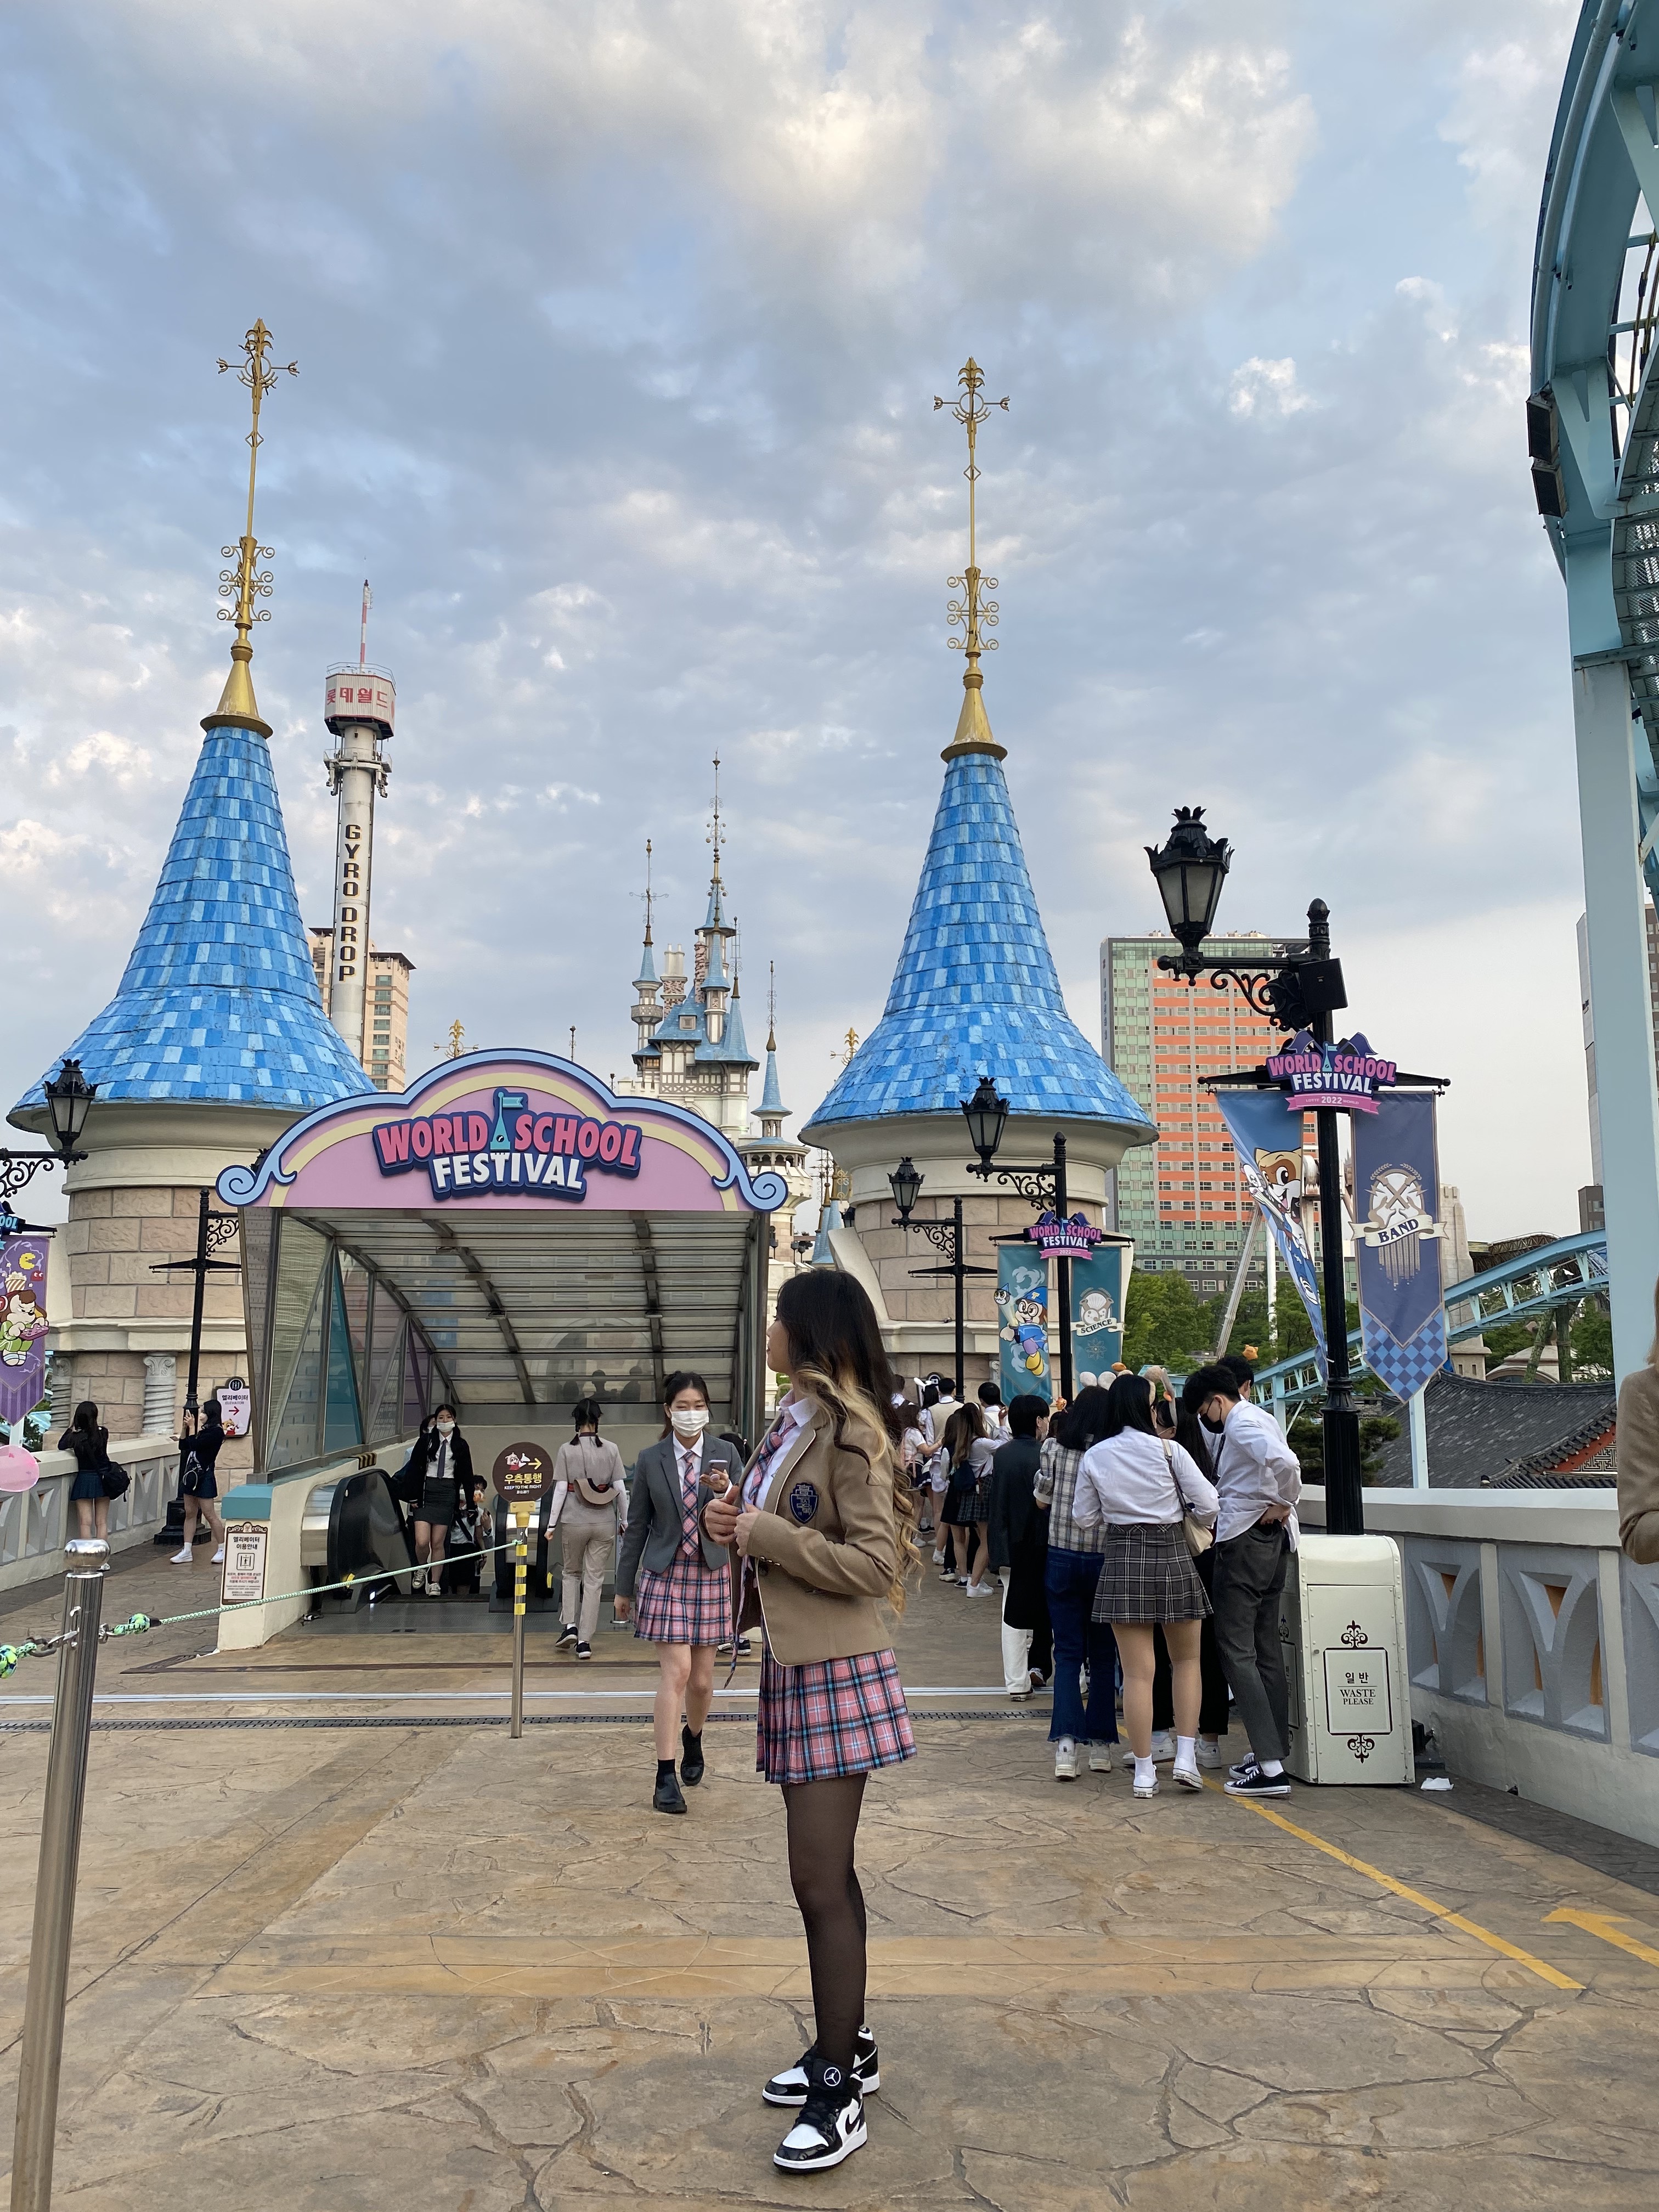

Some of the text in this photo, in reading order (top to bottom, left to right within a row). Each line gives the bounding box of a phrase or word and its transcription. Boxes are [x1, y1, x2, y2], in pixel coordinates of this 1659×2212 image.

[326, 687, 388, 708] 롯데월드
[339, 824, 362, 982] GYRO DROP
[1268, 1054, 1396, 1082] WORLD SCHOOL
[1291, 1072, 1373, 1094] FESTIVAL
[1321, 1096, 1342, 1104] 2022
[377, 1114, 638, 1166] WORLD SCHOOL
[432, 1152, 583, 1190] FESTIVAL
[1029, 1224, 1102, 1240] WORLD SCHOOL
[1378, 1218, 1419, 1243] BAND
[1042, 1235, 1089, 1248] FESTIVAL
[1081, 1319, 1113, 1334] SCIENCE
[504, 1472, 542, 1485] 우측통행
[1340, 1689, 1376, 1697] WASTE
